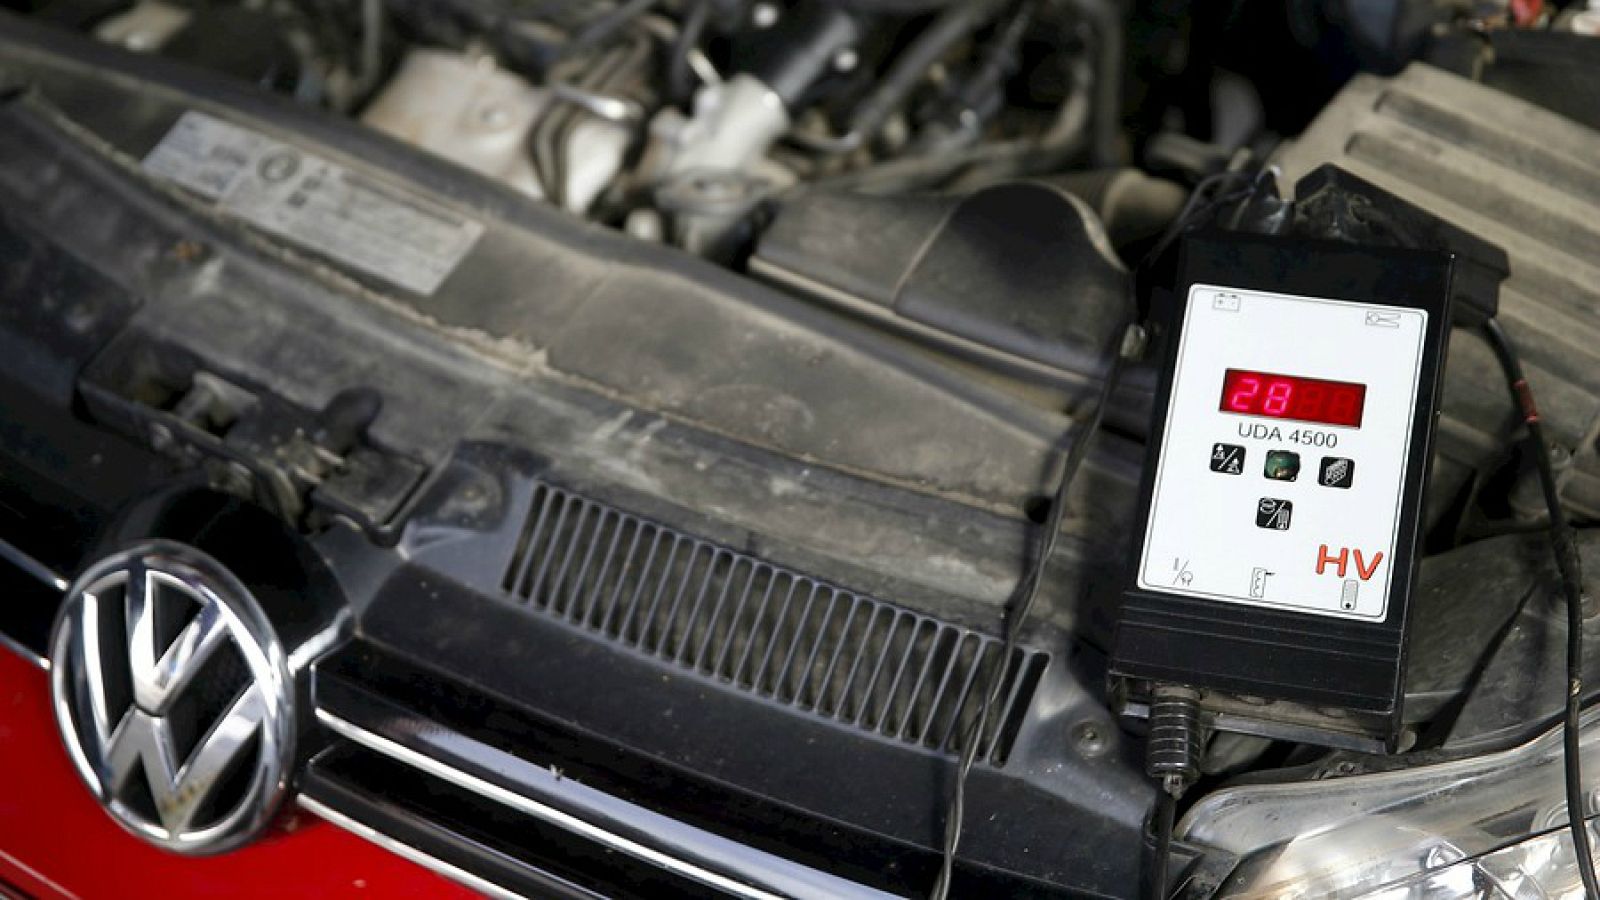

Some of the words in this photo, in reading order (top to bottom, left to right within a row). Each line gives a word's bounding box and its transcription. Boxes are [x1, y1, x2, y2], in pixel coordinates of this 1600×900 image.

[1231, 378, 1292, 415] 28
[1238, 422, 1282, 442] UDA
[1288, 429, 1338, 449] 4500
[1316, 544, 1384, 581] HV
